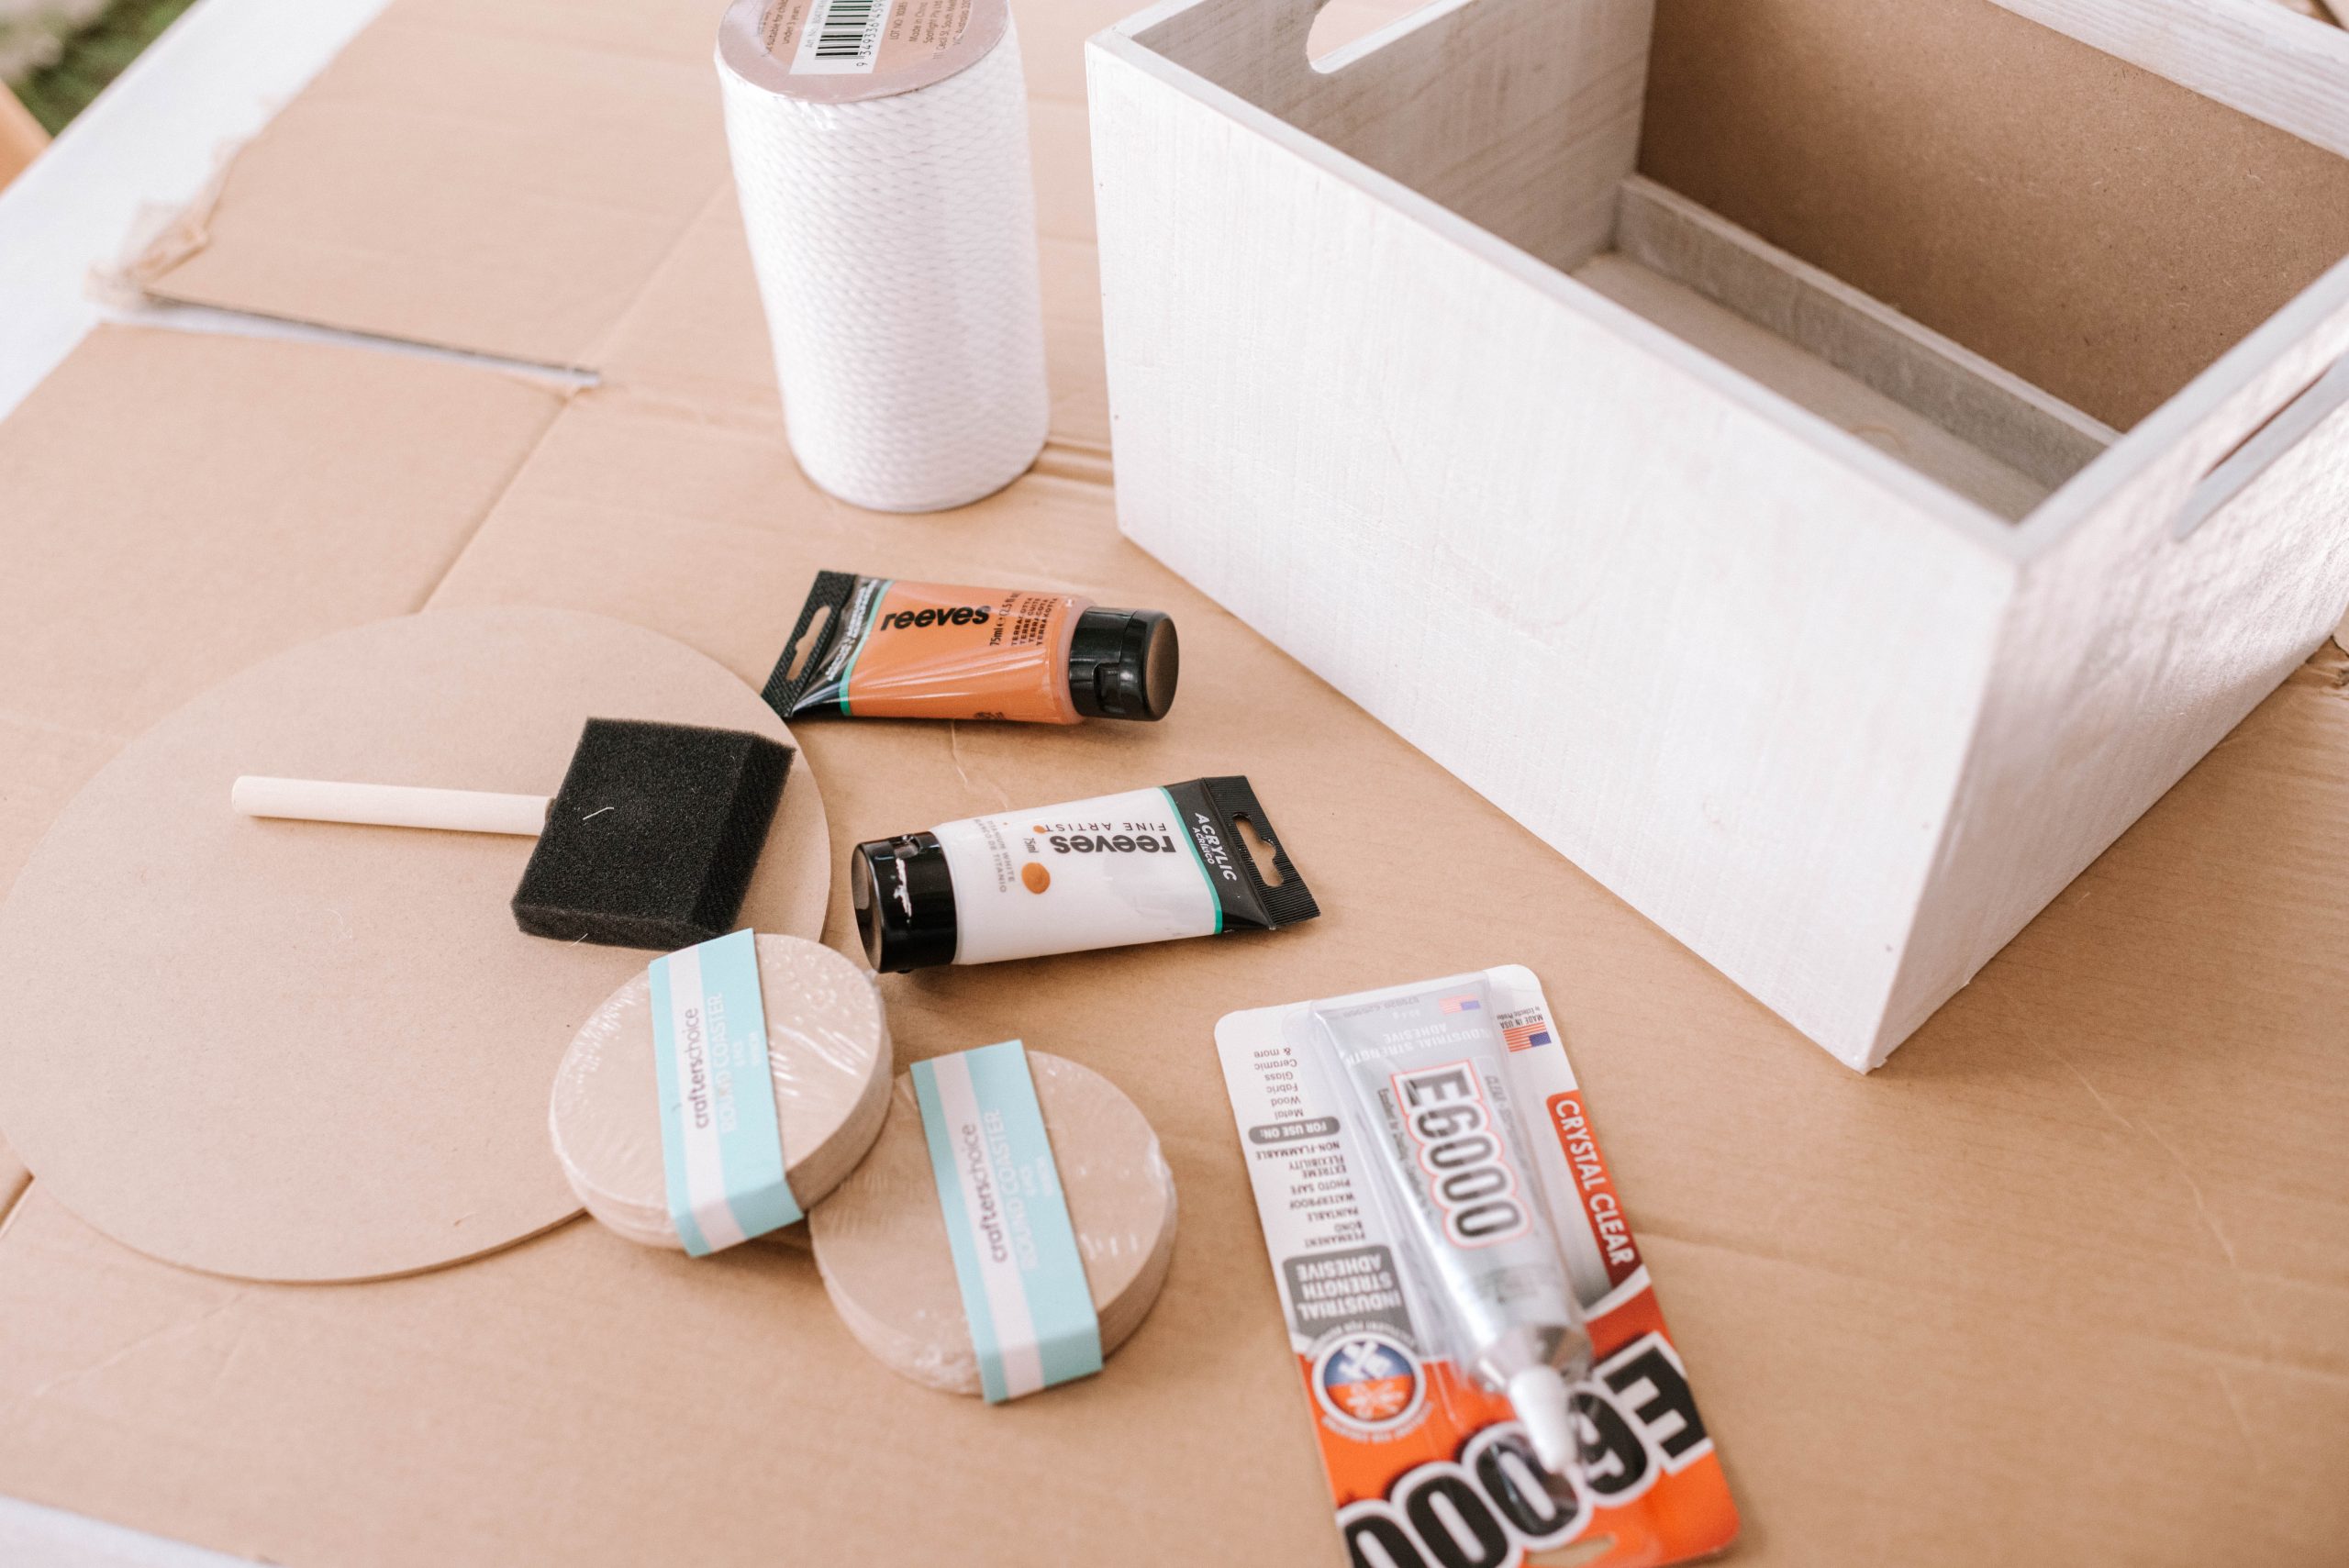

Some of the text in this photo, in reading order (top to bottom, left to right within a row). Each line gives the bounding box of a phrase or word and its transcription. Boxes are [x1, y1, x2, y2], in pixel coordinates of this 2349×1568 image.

[908, 25, 921, 42] Made
[880, 606, 989, 630] reeves
[1019, 618, 1032, 645] TERRE
[1044, 822, 1167, 832] FINE ARTIST
[1023, 837, 1040, 853] 75ml
[1049, 835, 1176, 854] reeves
[1195, 812, 1237, 881] ACRYLIC
[993, 853, 1007, 893] TITANIO
[1001, 851, 1016, 882] WHITE
[707, 992, 730, 1068] COASTER
[1500, 1014, 1544, 1029] MADE IN USA
[1253, 1047, 1291, 1059] & more
[682, 1007, 709, 1129] crafterschoice
[1254, 1058, 1297, 1071] Ceramic
[1264, 1071, 1294, 1082] Glass
[1266, 1083, 1298, 1095] Fabric
[1271, 1095, 1301, 1106] Wood
[1275, 1108, 1304, 1120] Metal
[1260, 1120, 1327, 1140] FOR USE ON:
[1255, 1140, 1341, 1161] NON-FLAMMABLE
[1403, 1065, 1523, 1240] E6000
[1289, 1154, 1344, 1171] FLEXIBILITY
[1302, 1164, 1347, 1179] EXTREME
[1290, 1179, 1351, 1195] PHOTO SAFE
[1556, 1099, 1635, 1265] CRYSTAL CLEAR
[963, 1123, 1008, 1263] crafterschoice
[1289, 1193, 1355, 1210] WATERPROOF
[1308, 1207, 1359, 1222] PAINTABLE
[1304, 1232, 1365, 1249] PERMANENT
[1295, 1253, 1382, 1282] ADHESIVE
[1301, 1272, 1394, 1300] STRENGTH
[1297, 1289, 1403, 1321] INDUSTRIAL
